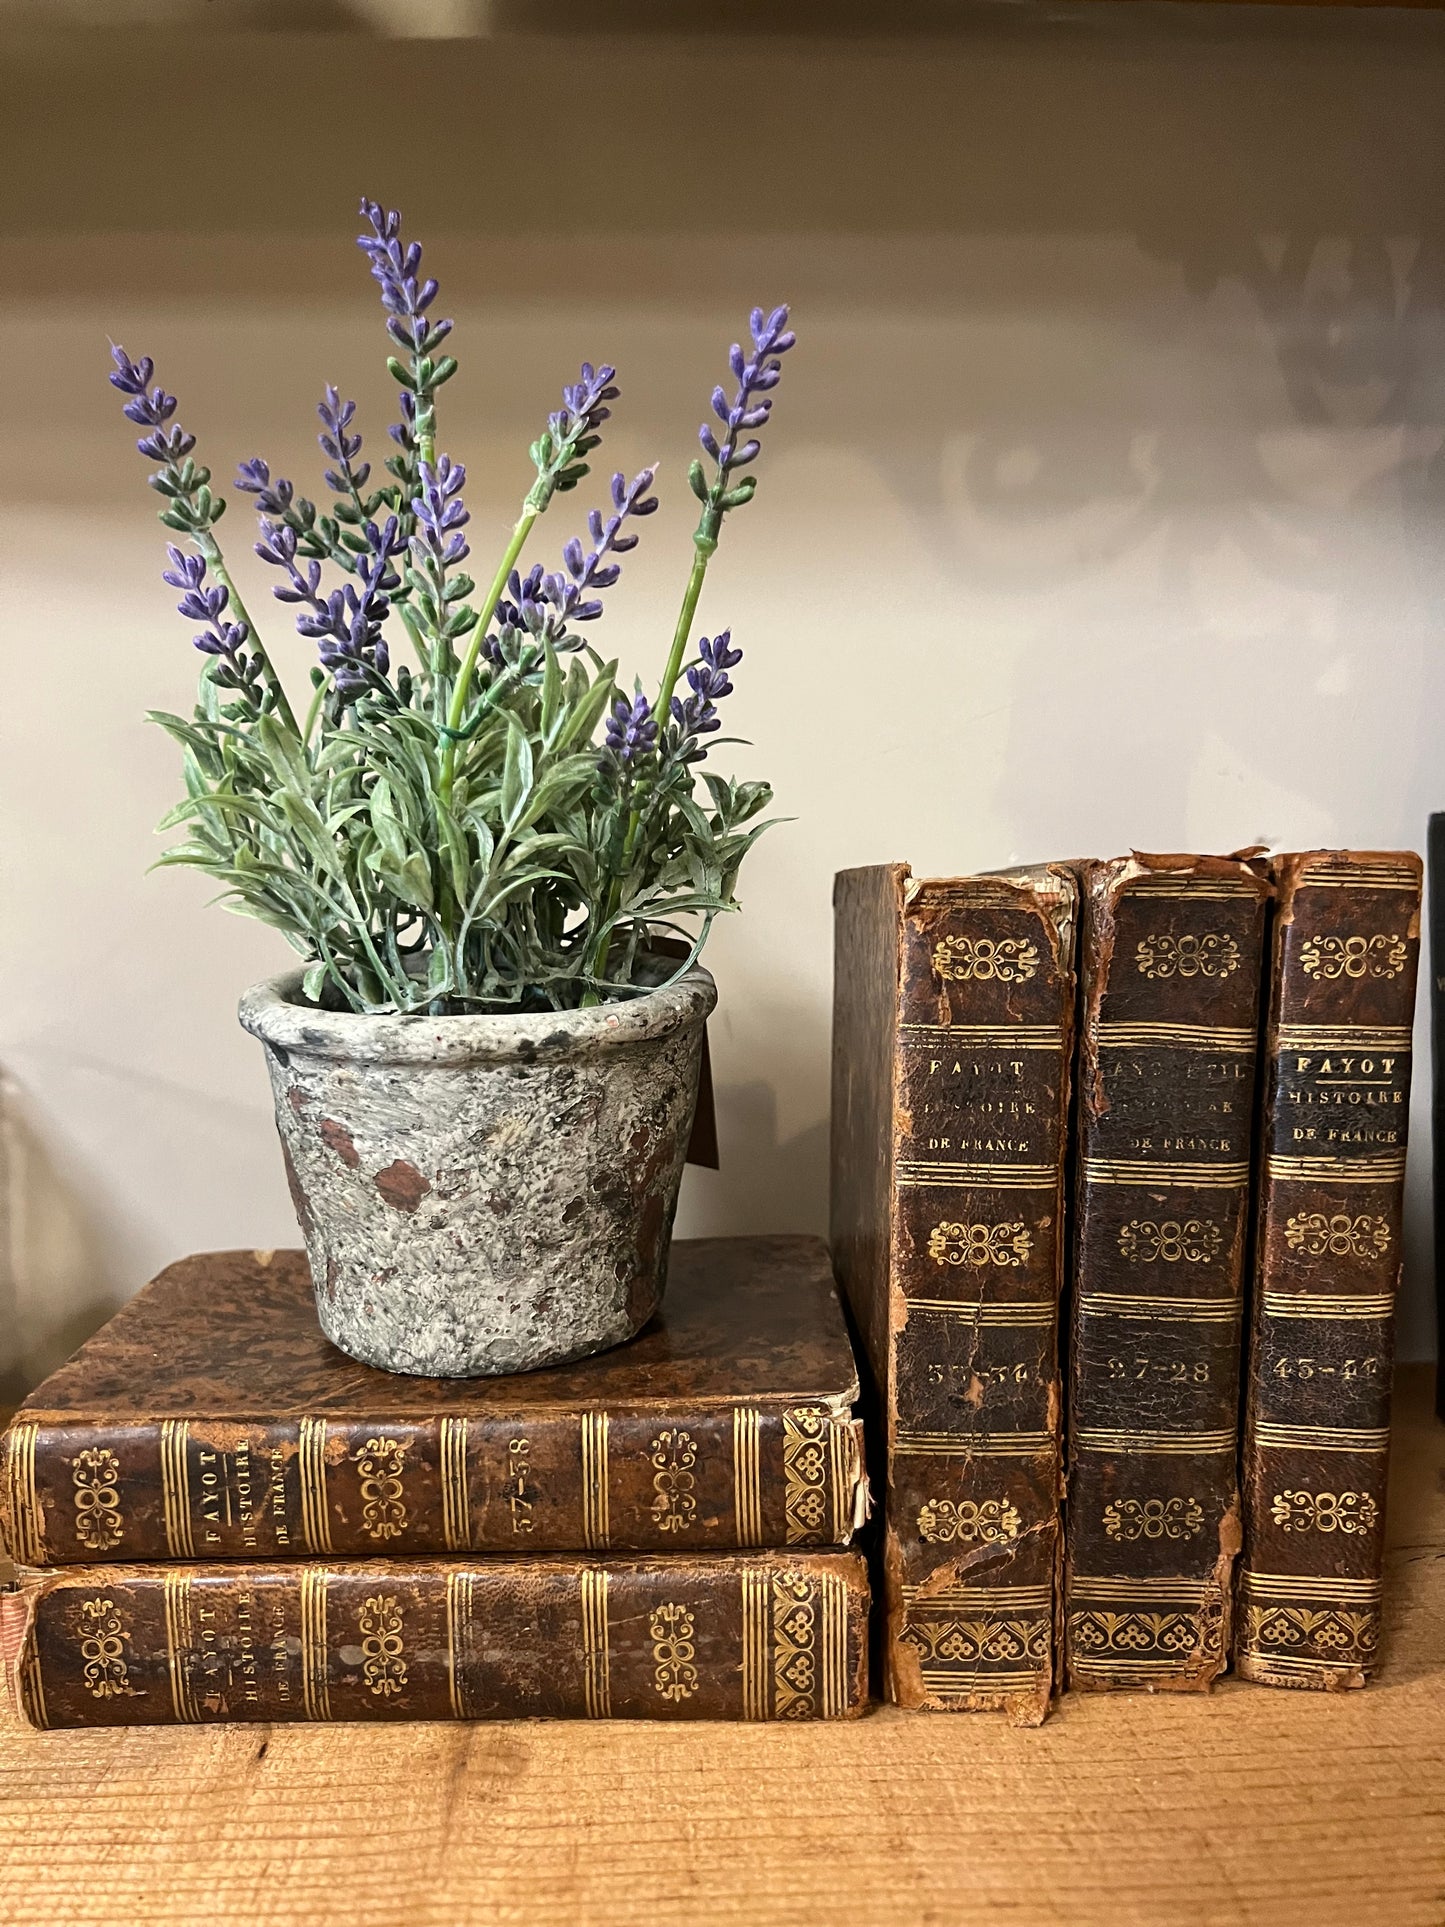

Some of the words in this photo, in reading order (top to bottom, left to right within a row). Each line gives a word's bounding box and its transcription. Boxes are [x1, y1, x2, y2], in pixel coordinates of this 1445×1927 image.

[1288, 1091, 1403, 1105] HISTOIRE
[929, 1137, 951, 1150] DE
[960, 1138, 1029, 1152] FRANCE
[1163, 1138, 1231, 1151] FRANCE
[1292, 1127, 1317, 1142] DE
[1327, 1128, 1397, 1143] FRANCE
[271, 1448, 286, 1516] FRANCE
[200, 1451, 221, 1543] FAYOT
[236, 1439, 257, 1547] HISTOIRE
[275, 1524, 290, 1545] DE
[238, 1593, 258, 1701] HISTOIRE
[273, 1606, 287, 1671] FRANCE
[278, 1681, 290, 1701] DE
